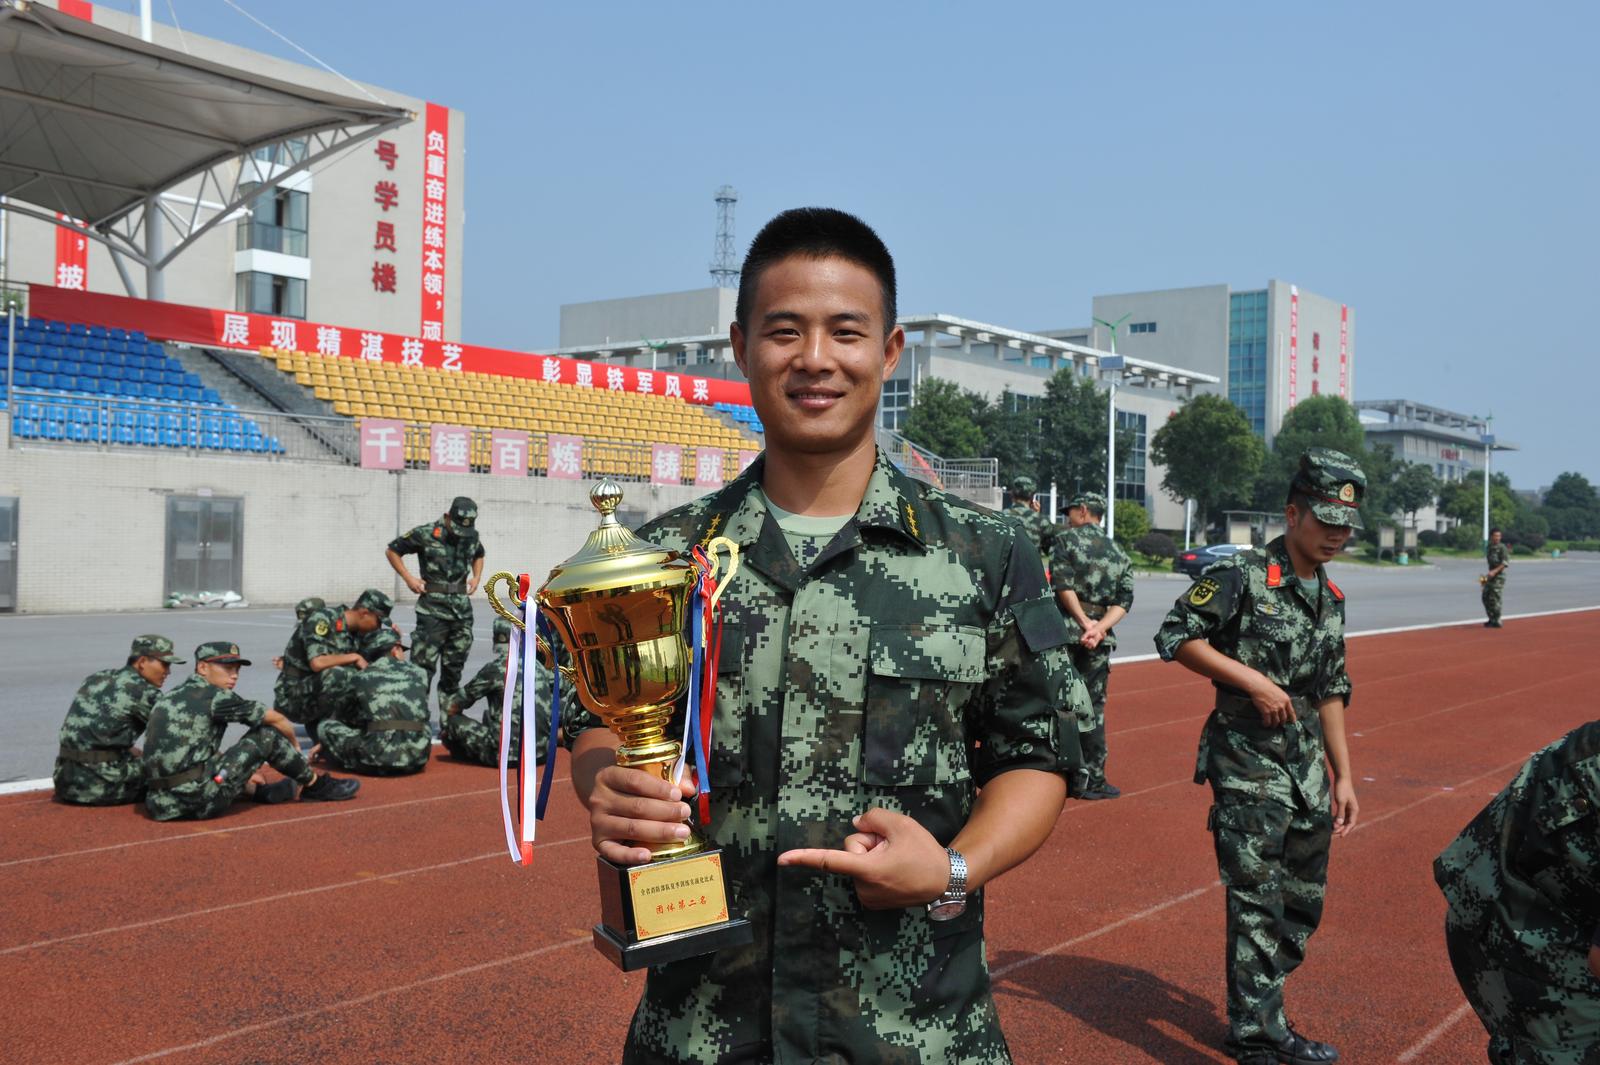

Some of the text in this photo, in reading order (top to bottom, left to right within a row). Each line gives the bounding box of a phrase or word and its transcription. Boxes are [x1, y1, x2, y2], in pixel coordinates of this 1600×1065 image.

[371, 139, 399, 294] 号学员楼
[57, 213, 85, 290] ，披
[221, 313, 463, 372] 展现精湛技艺
[366, 427, 757, 483] 千锤百炼 铸就
[656, 895, 707, 914] 团体第二名
